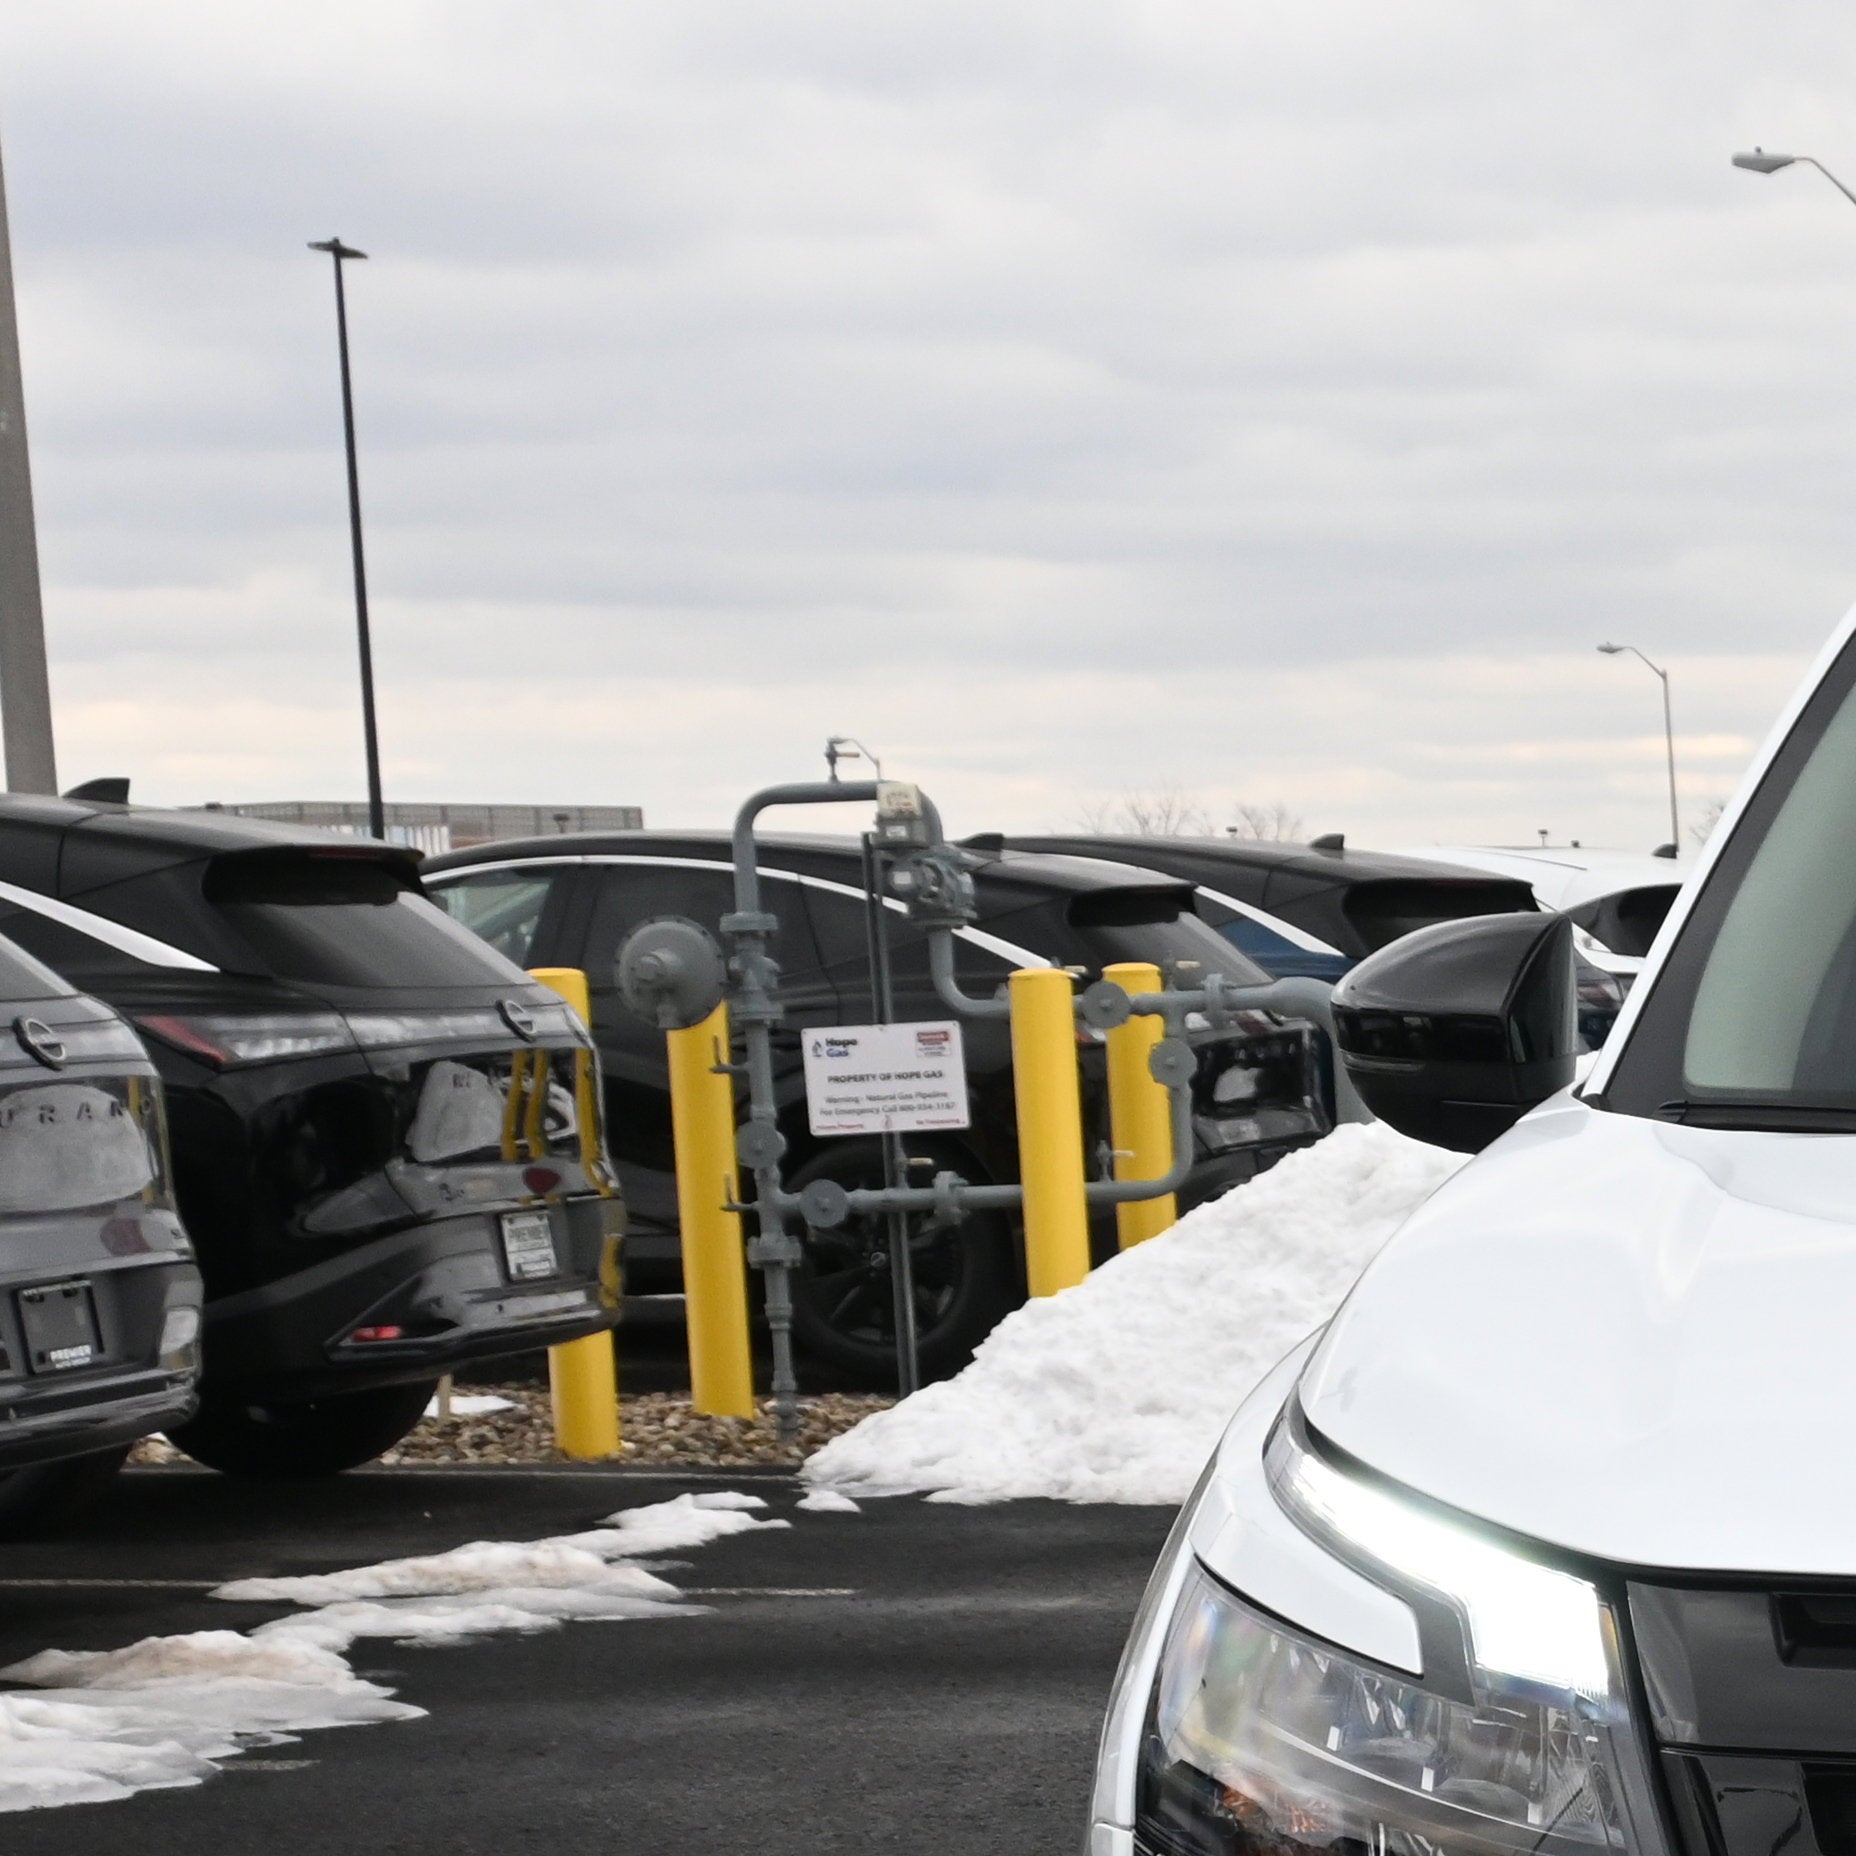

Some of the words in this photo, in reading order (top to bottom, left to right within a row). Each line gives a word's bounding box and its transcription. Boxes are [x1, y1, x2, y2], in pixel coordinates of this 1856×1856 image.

[825, 1037, 858, 1048] Hope
[826, 1047, 850, 1057] Gas
[827, 1072, 876, 1084] PROPERTY
[879, 1071, 892, 1081] OF
[895, 1070, 921, 1080] HOPE
[922, 1069, 943, 1079] GAS
[865, 1093, 896, 1102] Natural
[897, 1092, 913, 1101] Gas
[915, 1090, 948, 1101] Pipeline
[835, 1106, 880, 1116] Emergency
[882, 1104, 898, 1113] Call
